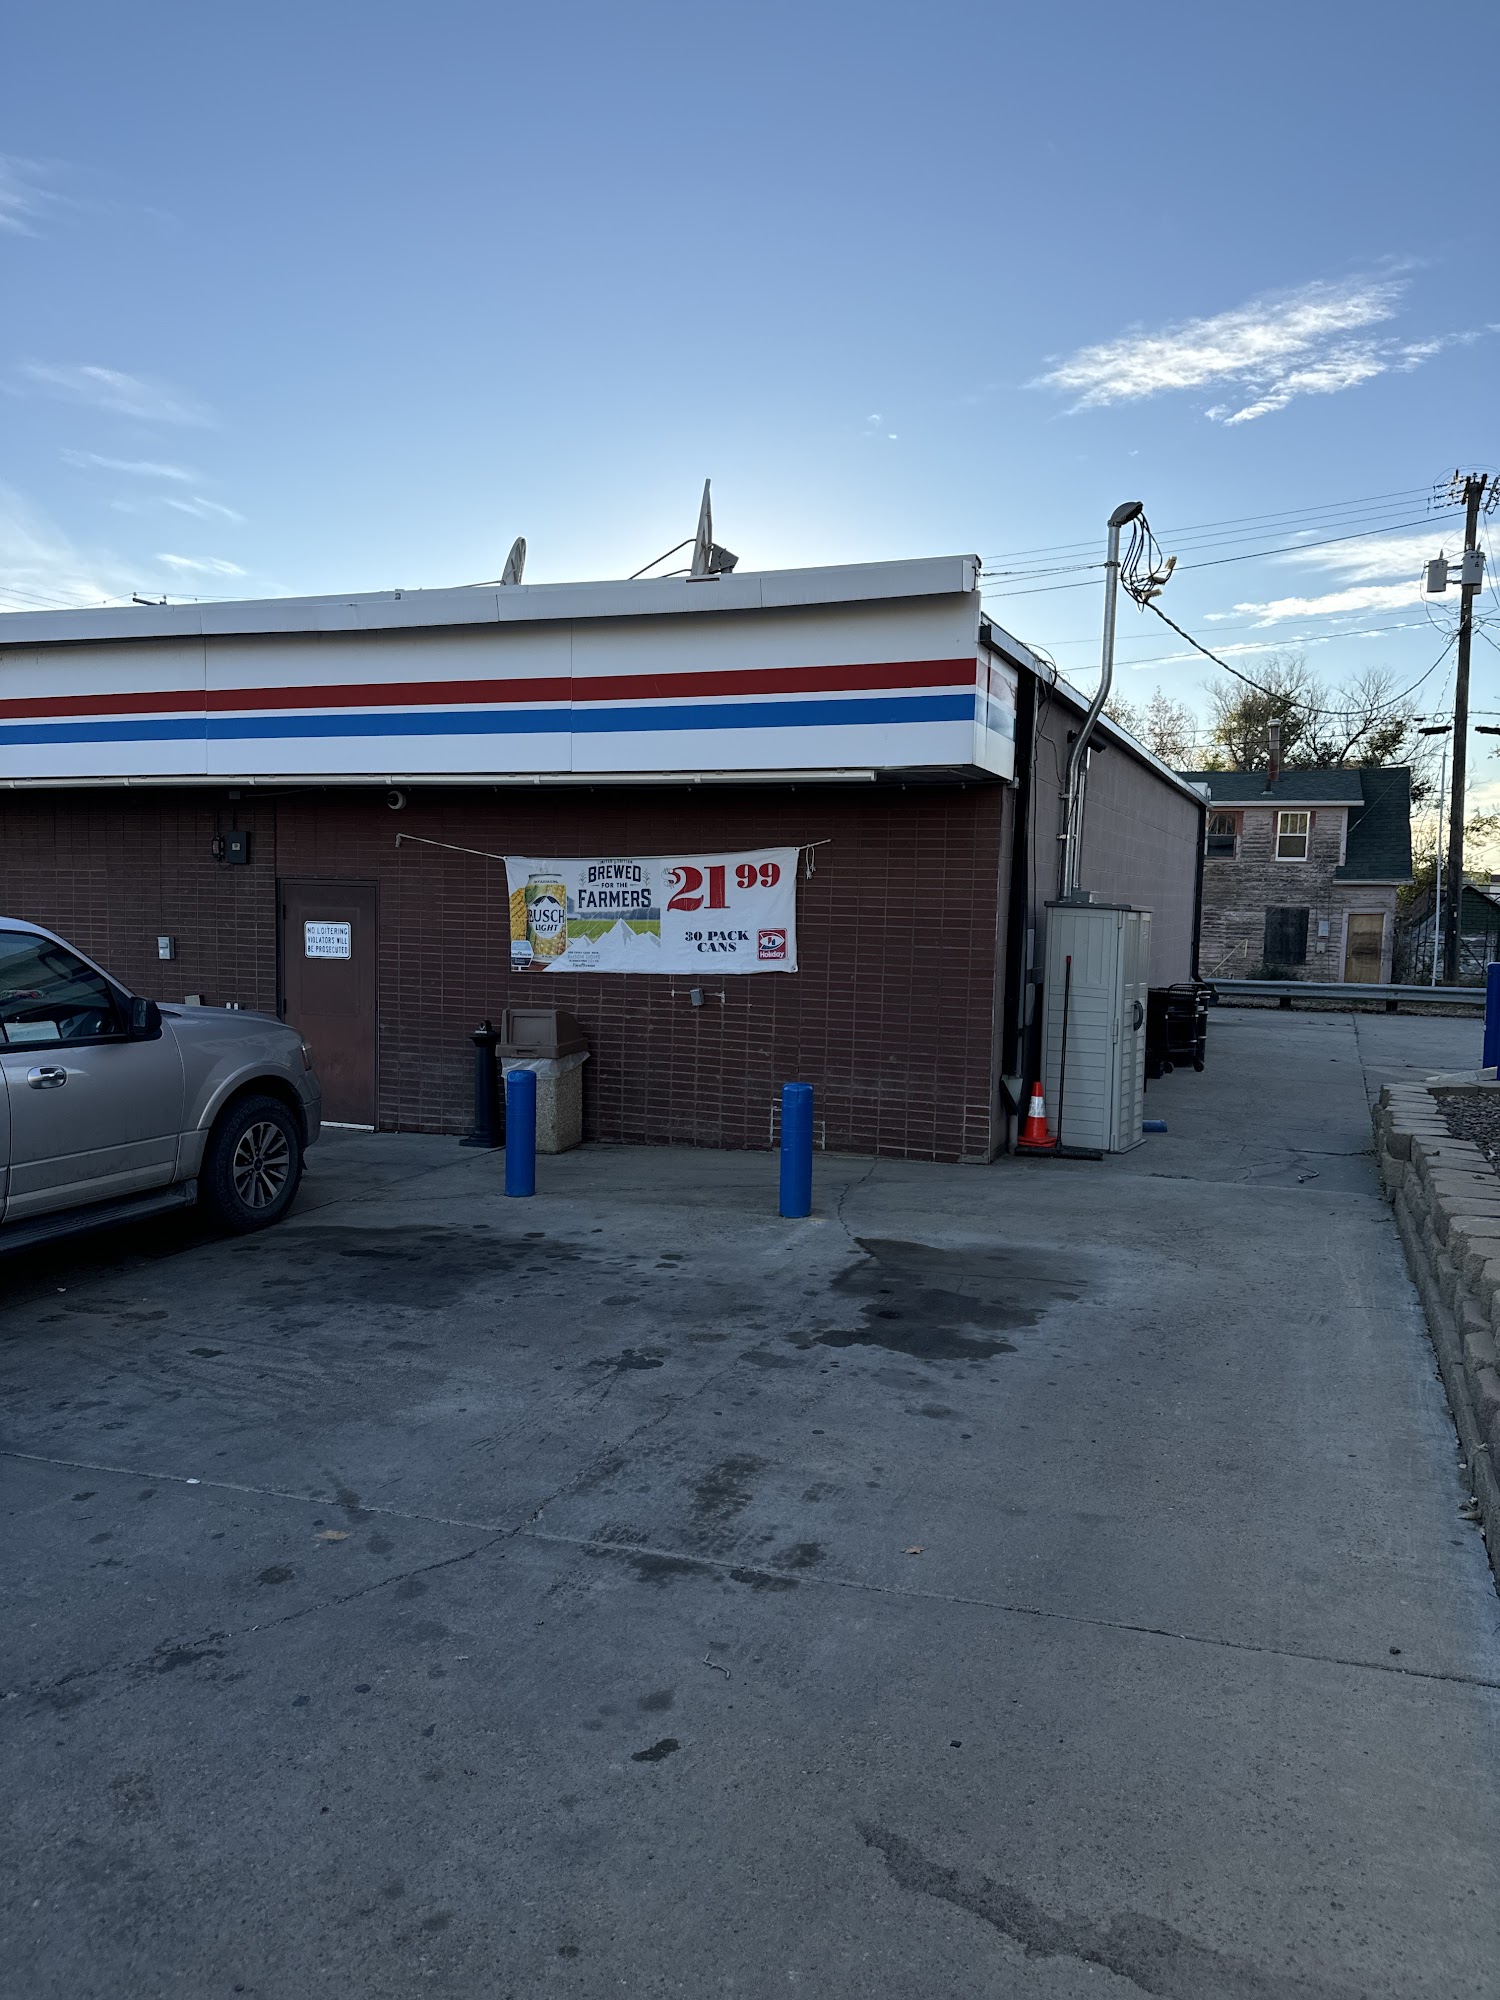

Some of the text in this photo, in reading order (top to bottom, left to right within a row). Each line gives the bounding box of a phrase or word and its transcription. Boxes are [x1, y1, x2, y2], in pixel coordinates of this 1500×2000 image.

[588, 864, 641, 883] BREWED
[578, 888, 652, 909] FARMERS
[529, 909, 565, 924] BUSCH
[317, 927, 348, 935] LOITERING
[535, 924, 558, 932] LIGHT
[308, 936, 348, 945] VIOLATORS WILL
[685, 930, 750, 941] 30 PACK
[308, 945, 348, 954] BE PROSECUTED
[697, 942, 737, 953] CANS
[759, 950, 785, 959] Holiday
